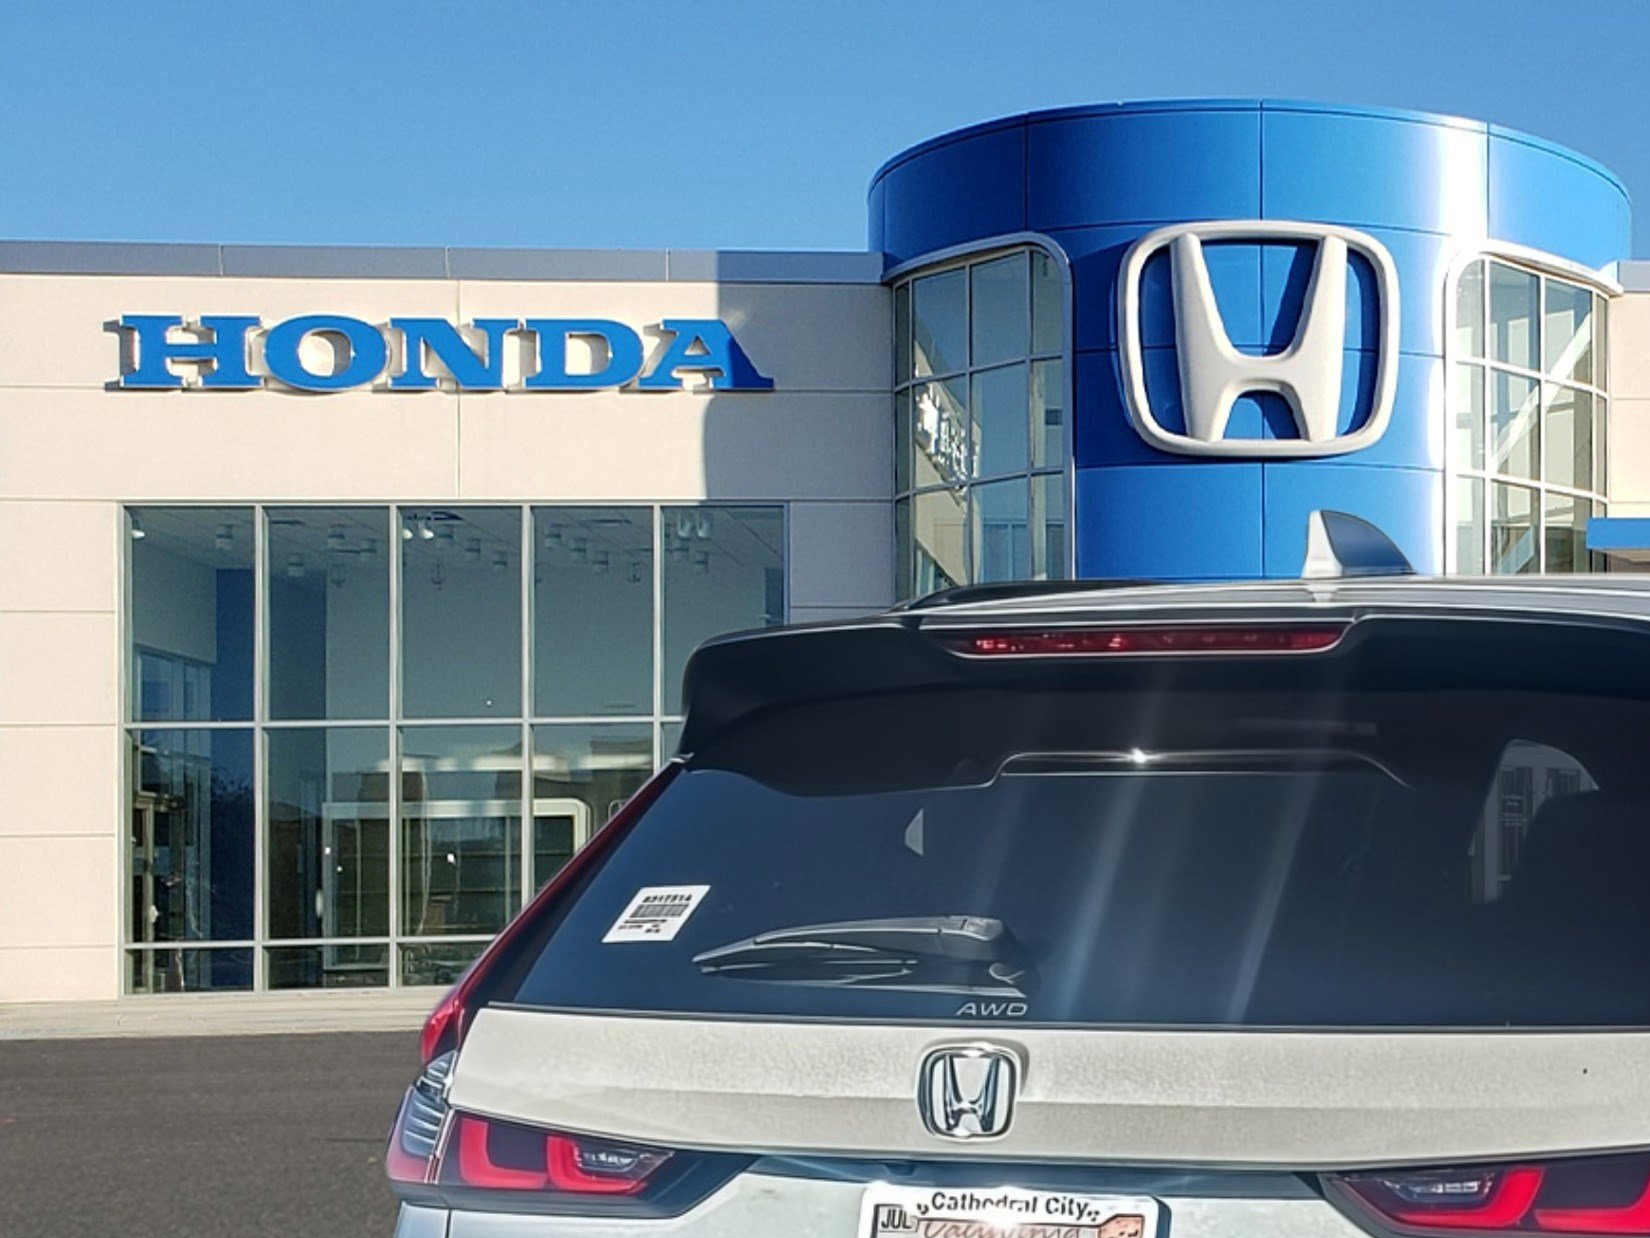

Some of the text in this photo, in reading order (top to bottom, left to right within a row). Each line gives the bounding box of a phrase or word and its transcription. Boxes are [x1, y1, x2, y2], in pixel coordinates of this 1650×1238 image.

[117, 314, 775, 391] HONDA
[955, 1002, 1028, 1016] AWD
[1045, 1196, 1089, 1219] City
[881, 1208, 913, 1230] JUL
